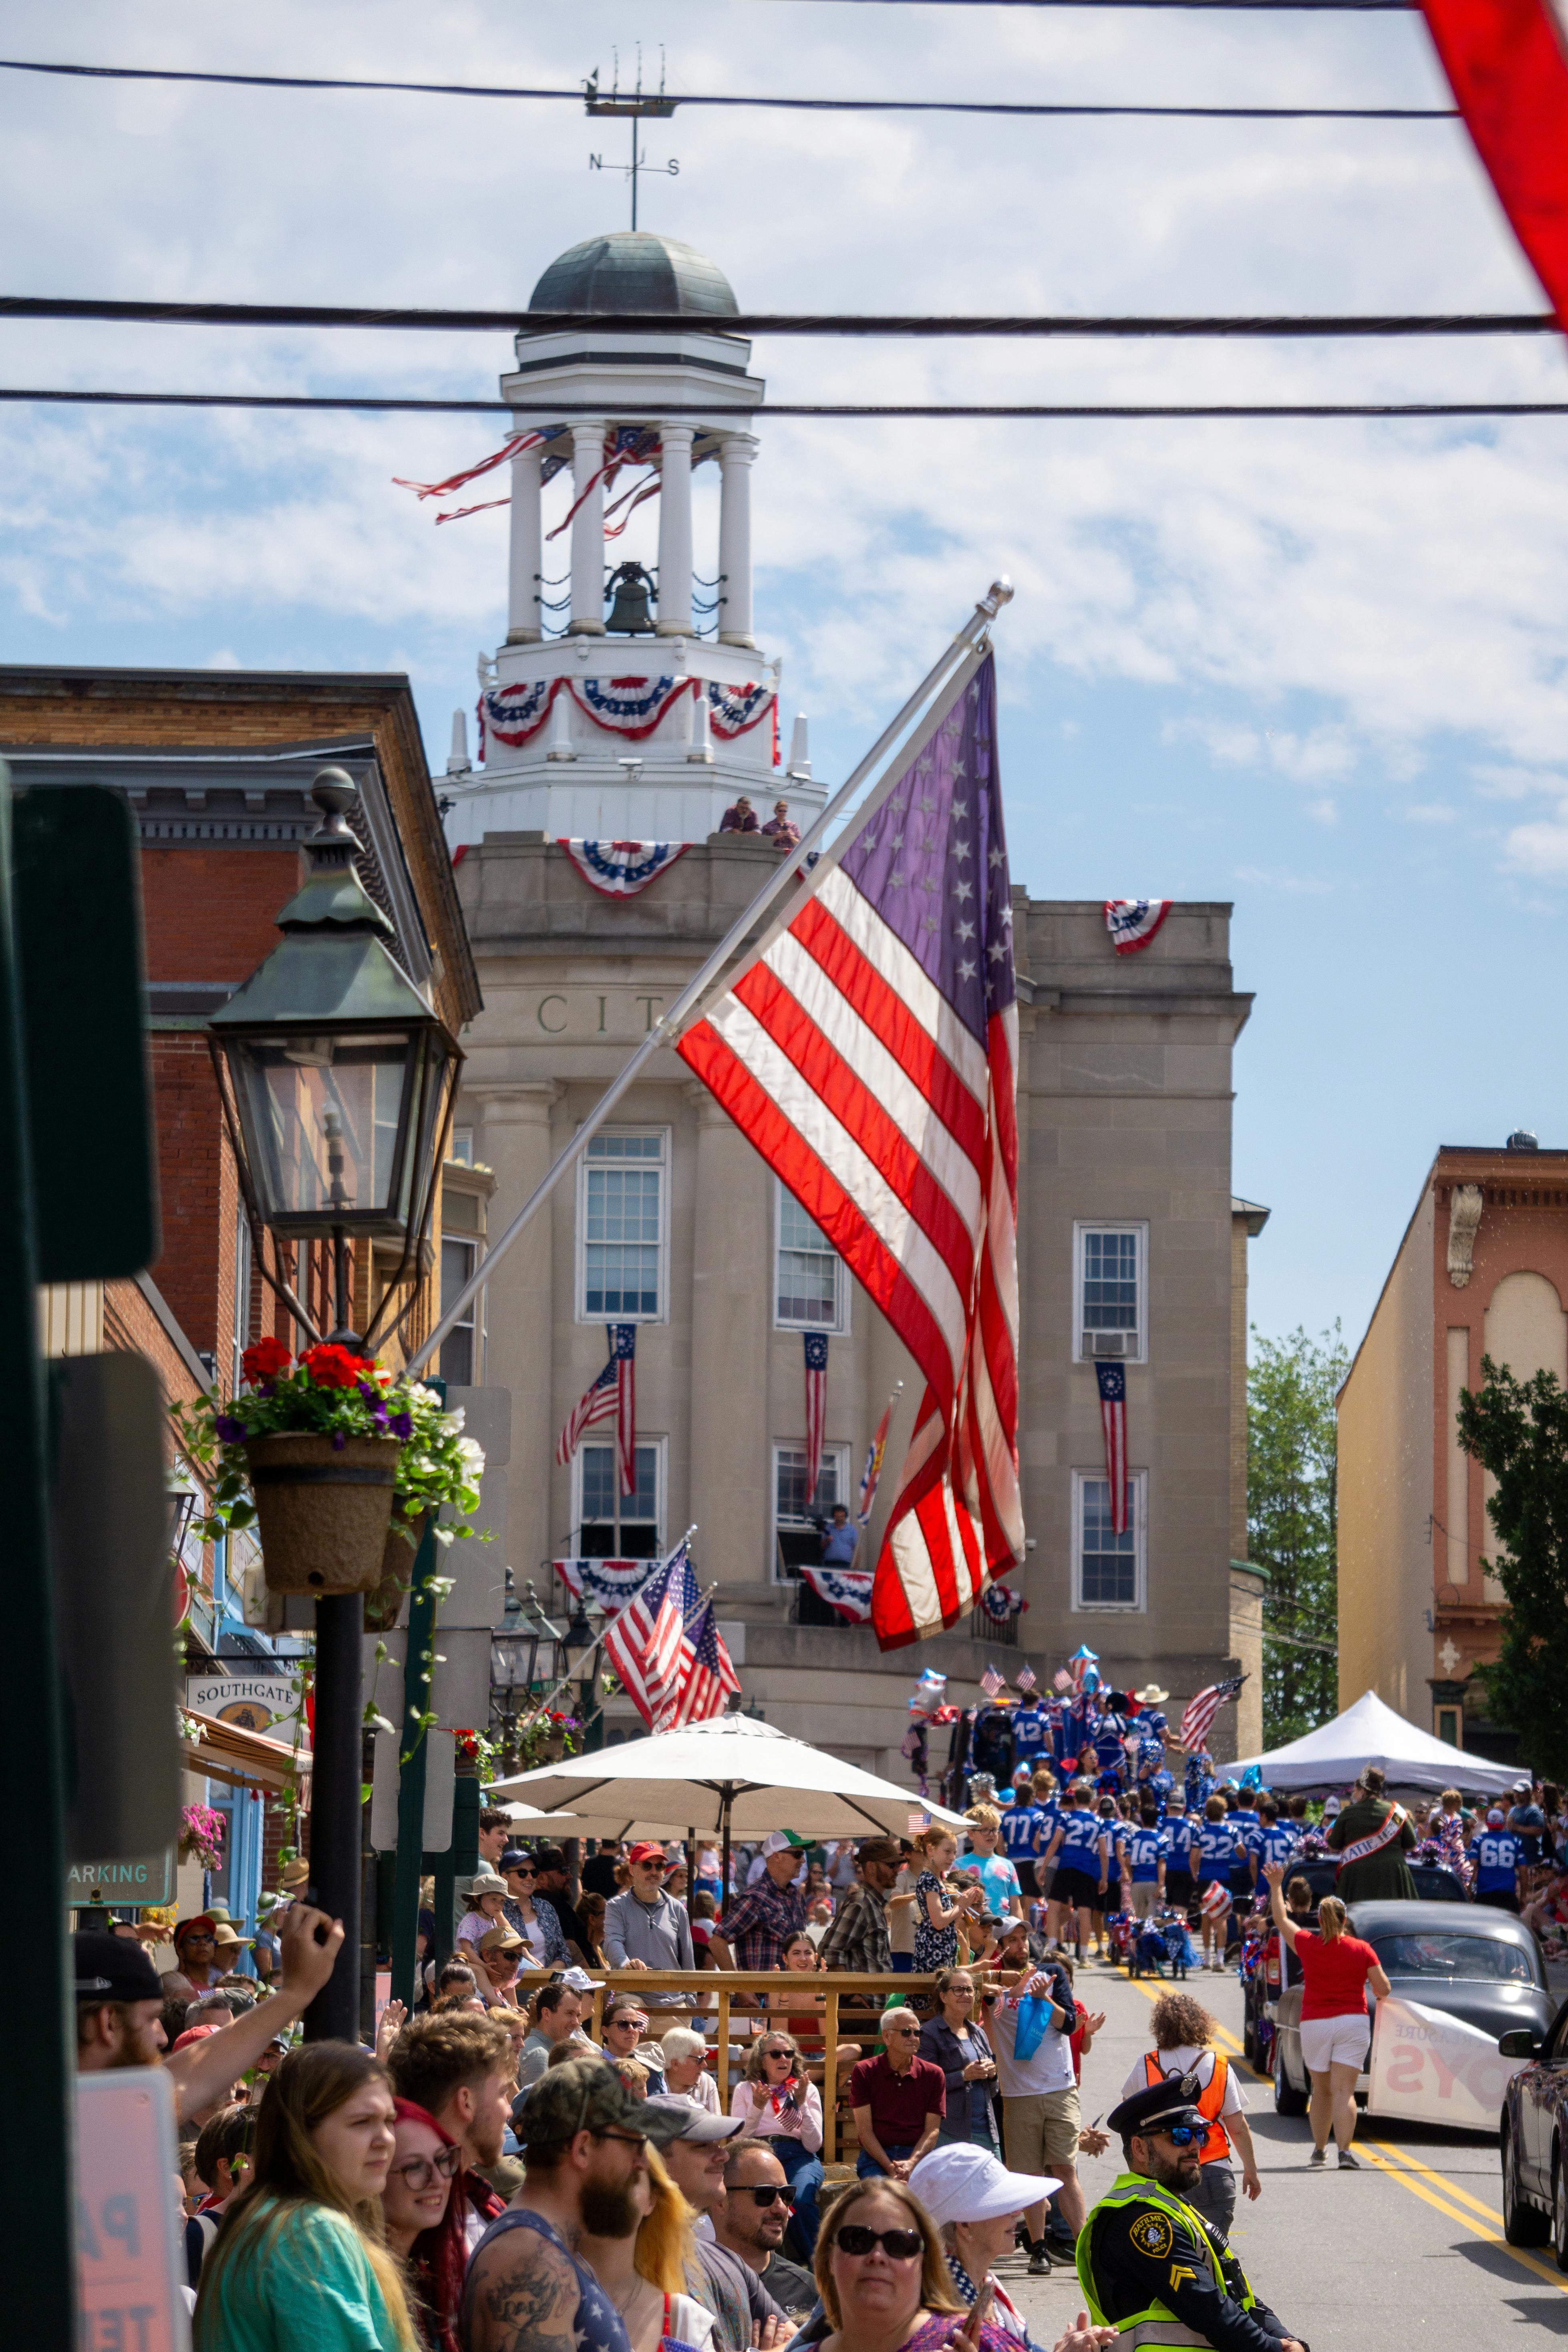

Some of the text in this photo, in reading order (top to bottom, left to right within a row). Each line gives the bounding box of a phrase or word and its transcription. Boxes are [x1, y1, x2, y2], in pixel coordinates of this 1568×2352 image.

[589, 153, 602, 170] N
[668, 159, 680, 175] S
[537, 995, 664, 1033] CIT
[197, 1683, 294, 1705] SOUTHGATE
[1012, 1721, 1042, 1742] 12
[1003, 1816, 1031, 1844] 77
[1065, 1819, 1099, 1848] 27
[1130, 1839, 1158, 1865] 16
[1200, 1833, 1234, 1860] 22
[1264, 1839, 1288, 1866] 15
[1480, 1839, 1516, 1868] 66
[67, 1865, 148, 1883] ARKING
[1152, 2243, 1167, 2253] POLICE
